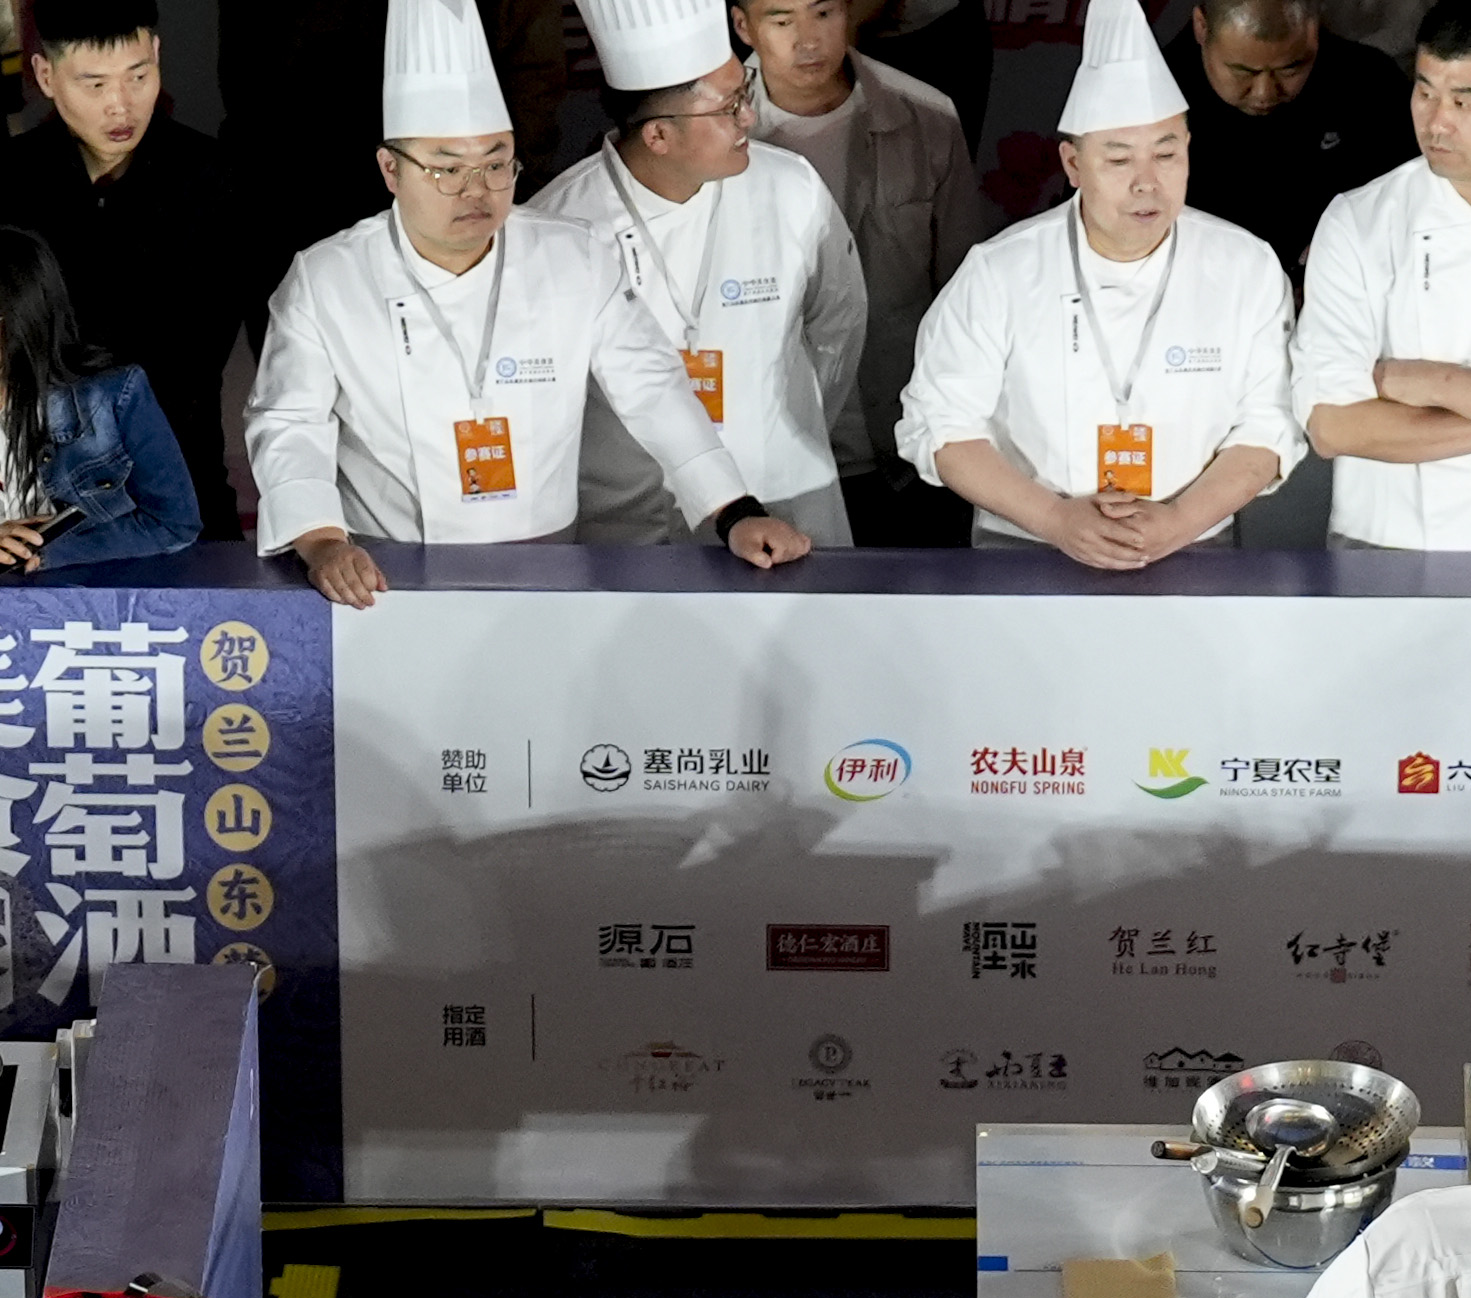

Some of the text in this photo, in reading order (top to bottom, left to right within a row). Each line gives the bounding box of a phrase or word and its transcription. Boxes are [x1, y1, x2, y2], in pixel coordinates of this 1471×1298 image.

[442, 749, 486, 771] 赞助
[644, 749, 770, 776] 塞尚乳业
[836, 758, 898, 783] 伊利
[970, 747, 1086, 777] 农夫山泉
[1220, 758, 1342, 783] 宁夏农垦
[442, 772, 487, 794] 单位
[644, 779, 770, 793] SAISHANG DAIRY
[971, 781, 1085, 795] NONGFU SPRING
[1219, 787, 1342, 796] NINGXIA STATE FARM
[1447, 785, 1466, 793] LIU
[28, 621, 196, 1006] 葡萄酒
[598, 924, 695, 955] 源石
[1109, 927, 1217, 958] 贺兰红
[1140, 962, 1169, 976] Lan
[1176, 962, 1217, 978] Hong
[444, 1005, 486, 1025] 指定
[444, 1027, 486, 1046] 用酒
